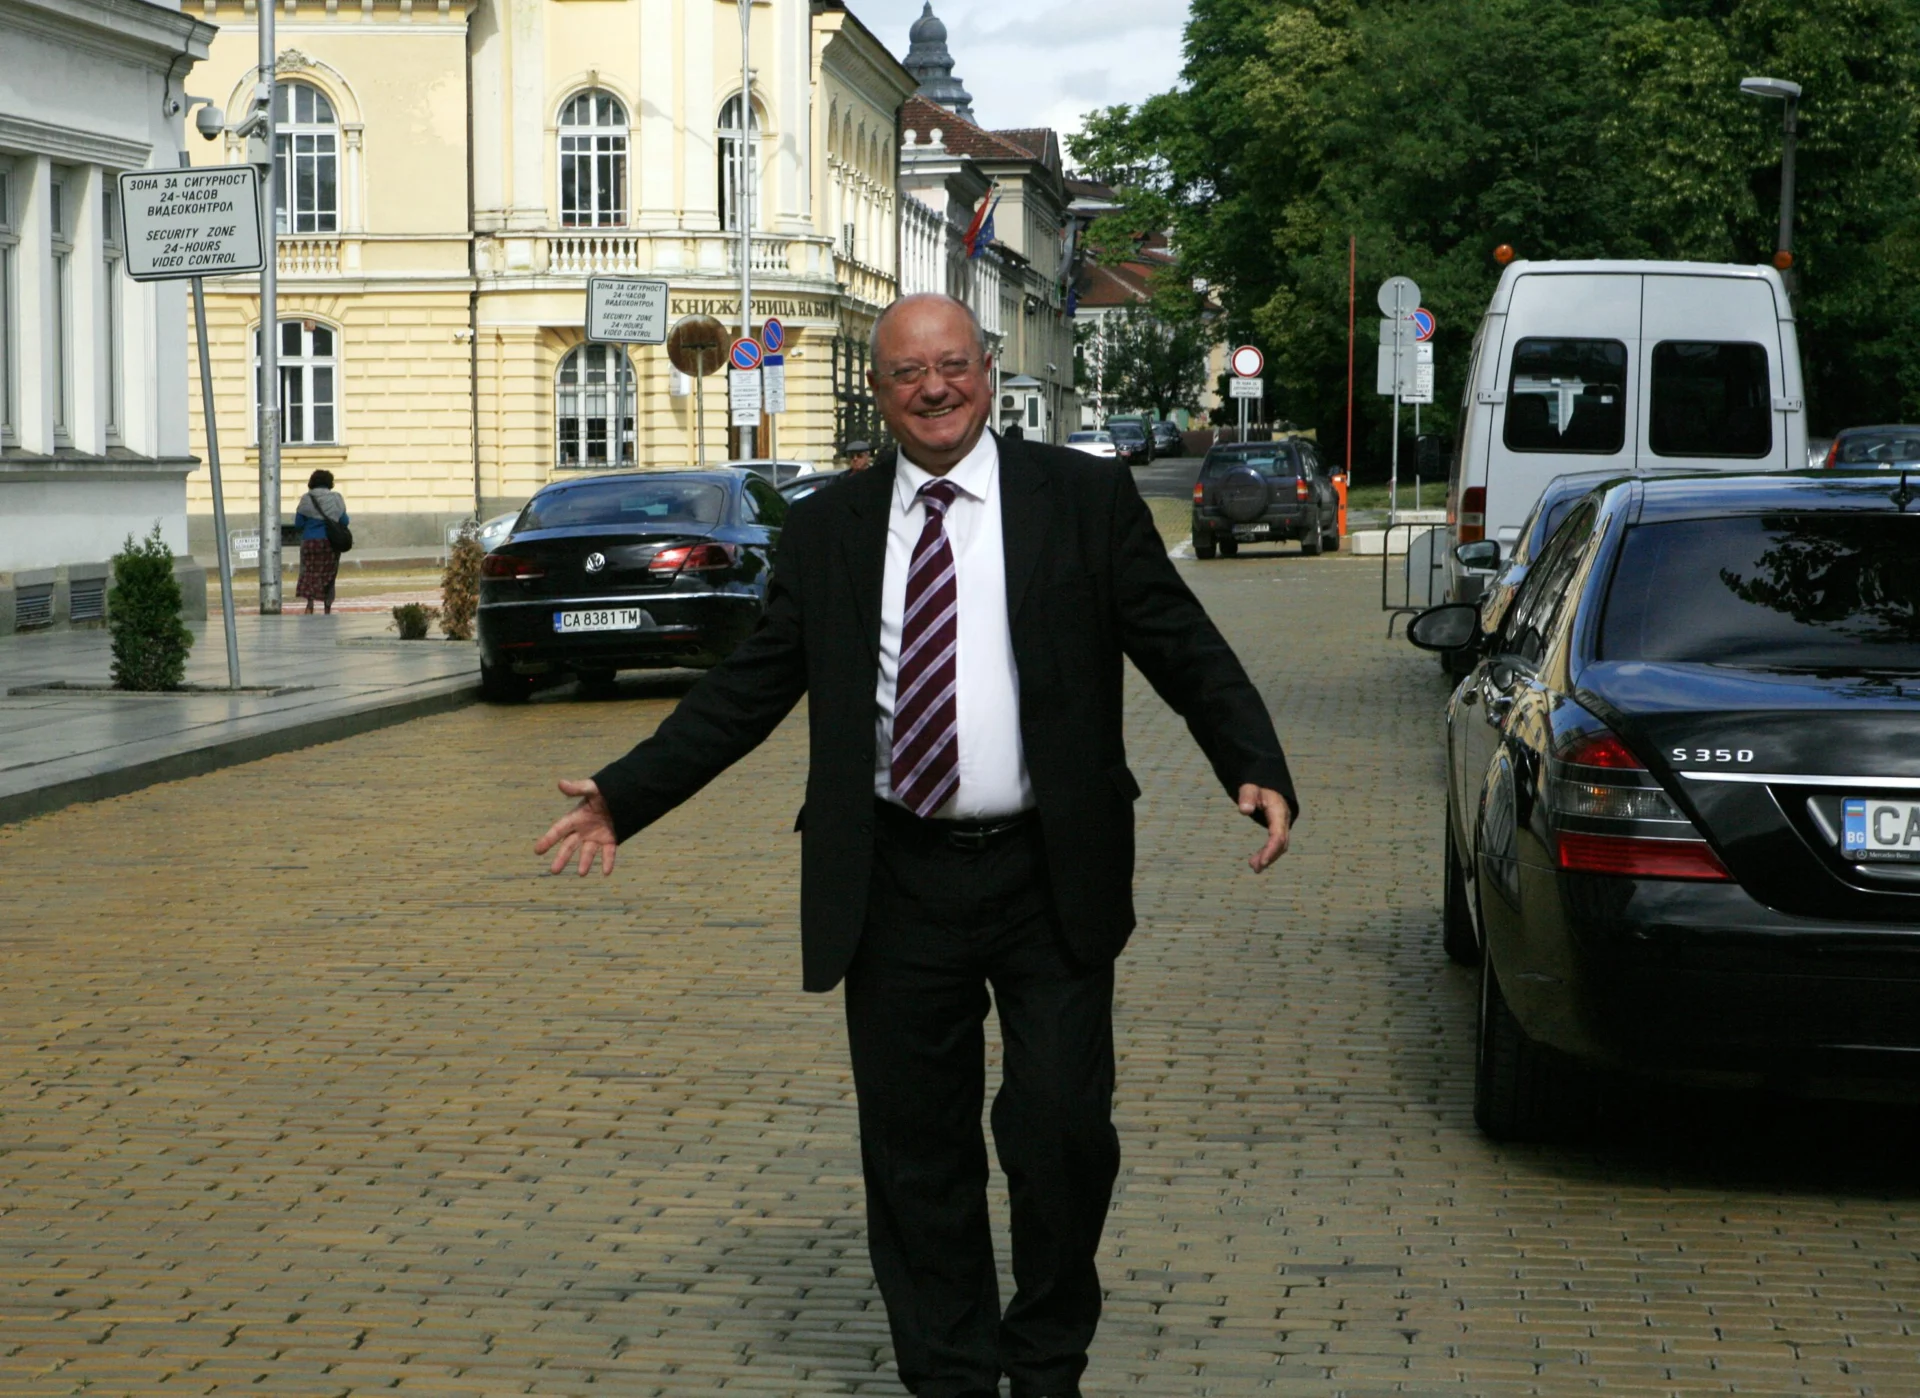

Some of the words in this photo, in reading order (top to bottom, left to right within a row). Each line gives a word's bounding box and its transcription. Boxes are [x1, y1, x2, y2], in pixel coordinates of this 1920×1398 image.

[129, 179, 158, 191] ЗОНА
[164, 178, 178, 189] ЗА
[184, 174, 247, 188] СИГУРНОСТ
[160, 189, 218, 203] 24-ЧАСОВ
[147, 201, 234, 217] ВИДЕОКОНТРОЛ
[146, 228, 199, 241] SECURITY
[207, 225, 237, 238] ZONE
[163, 240, 221, 254] 24-HOURS
[152, 256, 183, 268] VIDEO
[188, 253, 236, 266] CONTROL
[596, 282, 613, 290] ЗОНА
[626, 284, 663, 292] СИГУРНОСТ
[612, 291, 646, 300] 24-ЧАСОВ
[604, 299, 654, 307] ВИДЕОКОНТРОЛ
[602, 312, 632, 321] SECURITY
[635, 314, 653, 322] ZONE
[611, 321, 644, 330] 24-HOURS
[624, 330, 651, 338] CONTROL
[563, 613, 580, 627] CA
[583, 611, 615, 626] 8381
[620, 610, 637, 624] TM
[1672, 748, 1687, 761] S
[1695, 748, 1753, 762] 350
[1873, 805, 1920, 846] CA
[1847, 831, 1864, 844] BG
